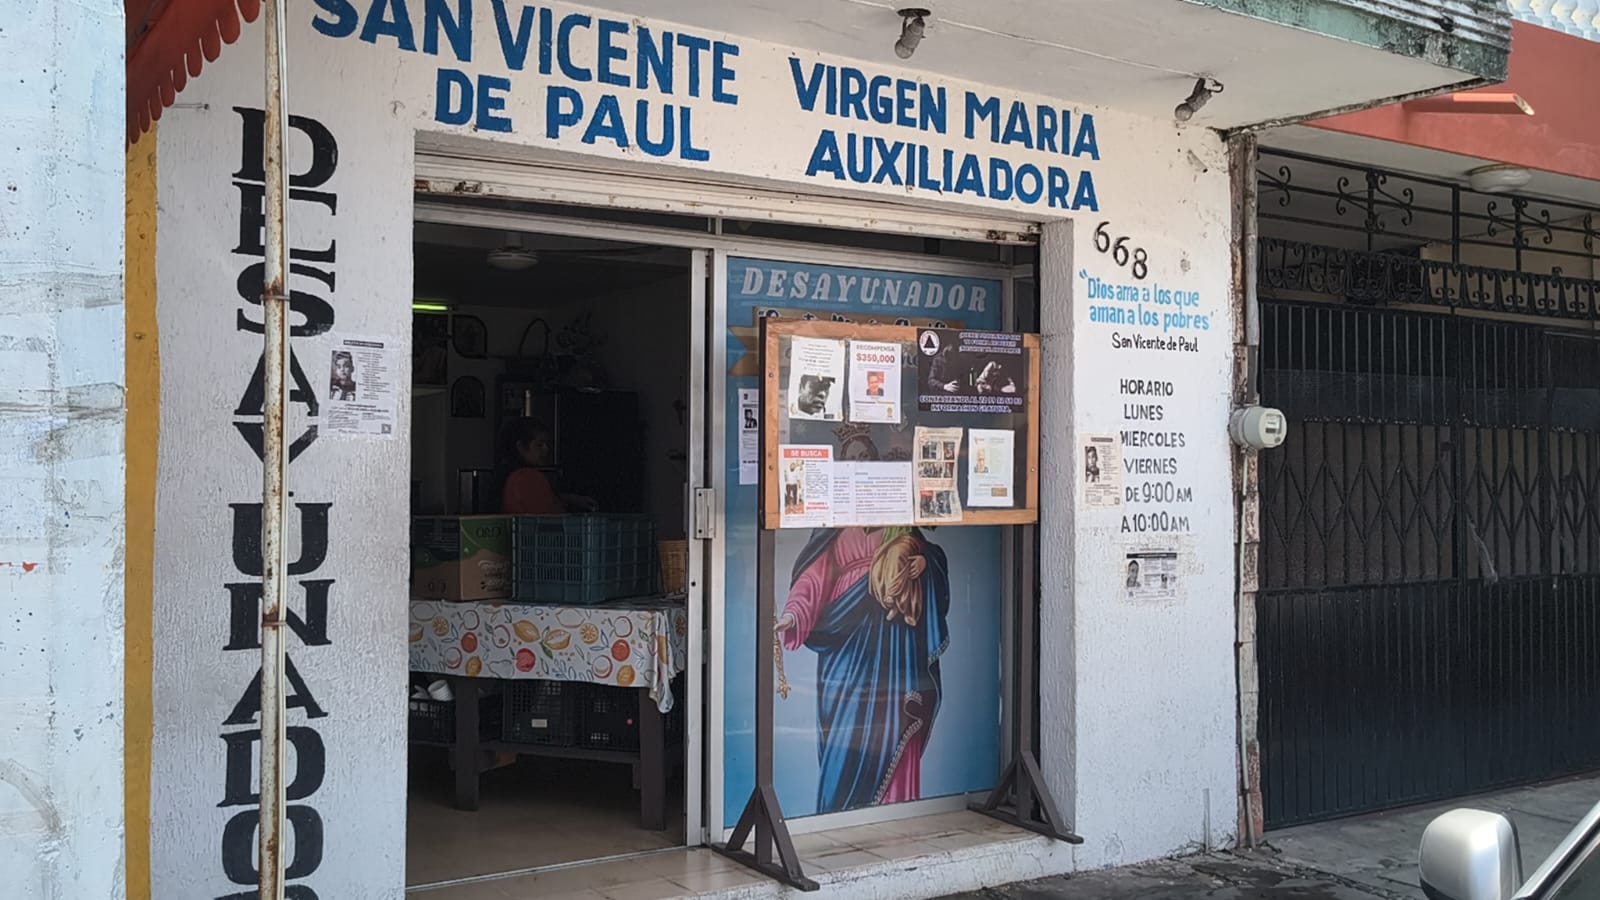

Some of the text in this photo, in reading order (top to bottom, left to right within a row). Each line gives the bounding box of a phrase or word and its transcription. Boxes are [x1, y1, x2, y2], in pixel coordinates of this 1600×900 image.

[312, 0, 740, 105] SAN VICENTE
[434, 68, 710, 162] DE PAUL
[788, 57, 1100, 161] VIRGEN MARIA
[805, 130, 1100, 213] AUXILIADORA
[1094, 221, 1149, 280] 668
[741, 266, 987, 313] DESAYUNADOR
[1116, 284, 1139, 302] ama
[1142, 288, 1150, 302] a
[1154, 283, 1171, 305] los
[1174, 289, 1200, 310] que
[1089, 304, 1126, 325] aman
[1127, 308, 1136, 325] a
[1138, 303, 1159, 327] los
[856, 344, 896, 352] RECOMPENSA
[1112, 331, 1199, 352] San Vicente de Paul
[856, 353, 896, 364] $350,000
[1120, 378, 1174, 397] HORARIO
[1123, 404, 1163, 422] LUNES
[1120, 430, 1186, 449] MIERCOLES
[1123, 458, 1177, 475] VIERNES
[214, 106, 338, 900] DESAYUNADO
[1125, 486, 1140, 503] DE
[1142, 480, 1175, 503] 9:00
[1176, 488, 1193, 502] AM
[1120, 511, 1190, 534] A 10:00 AM
